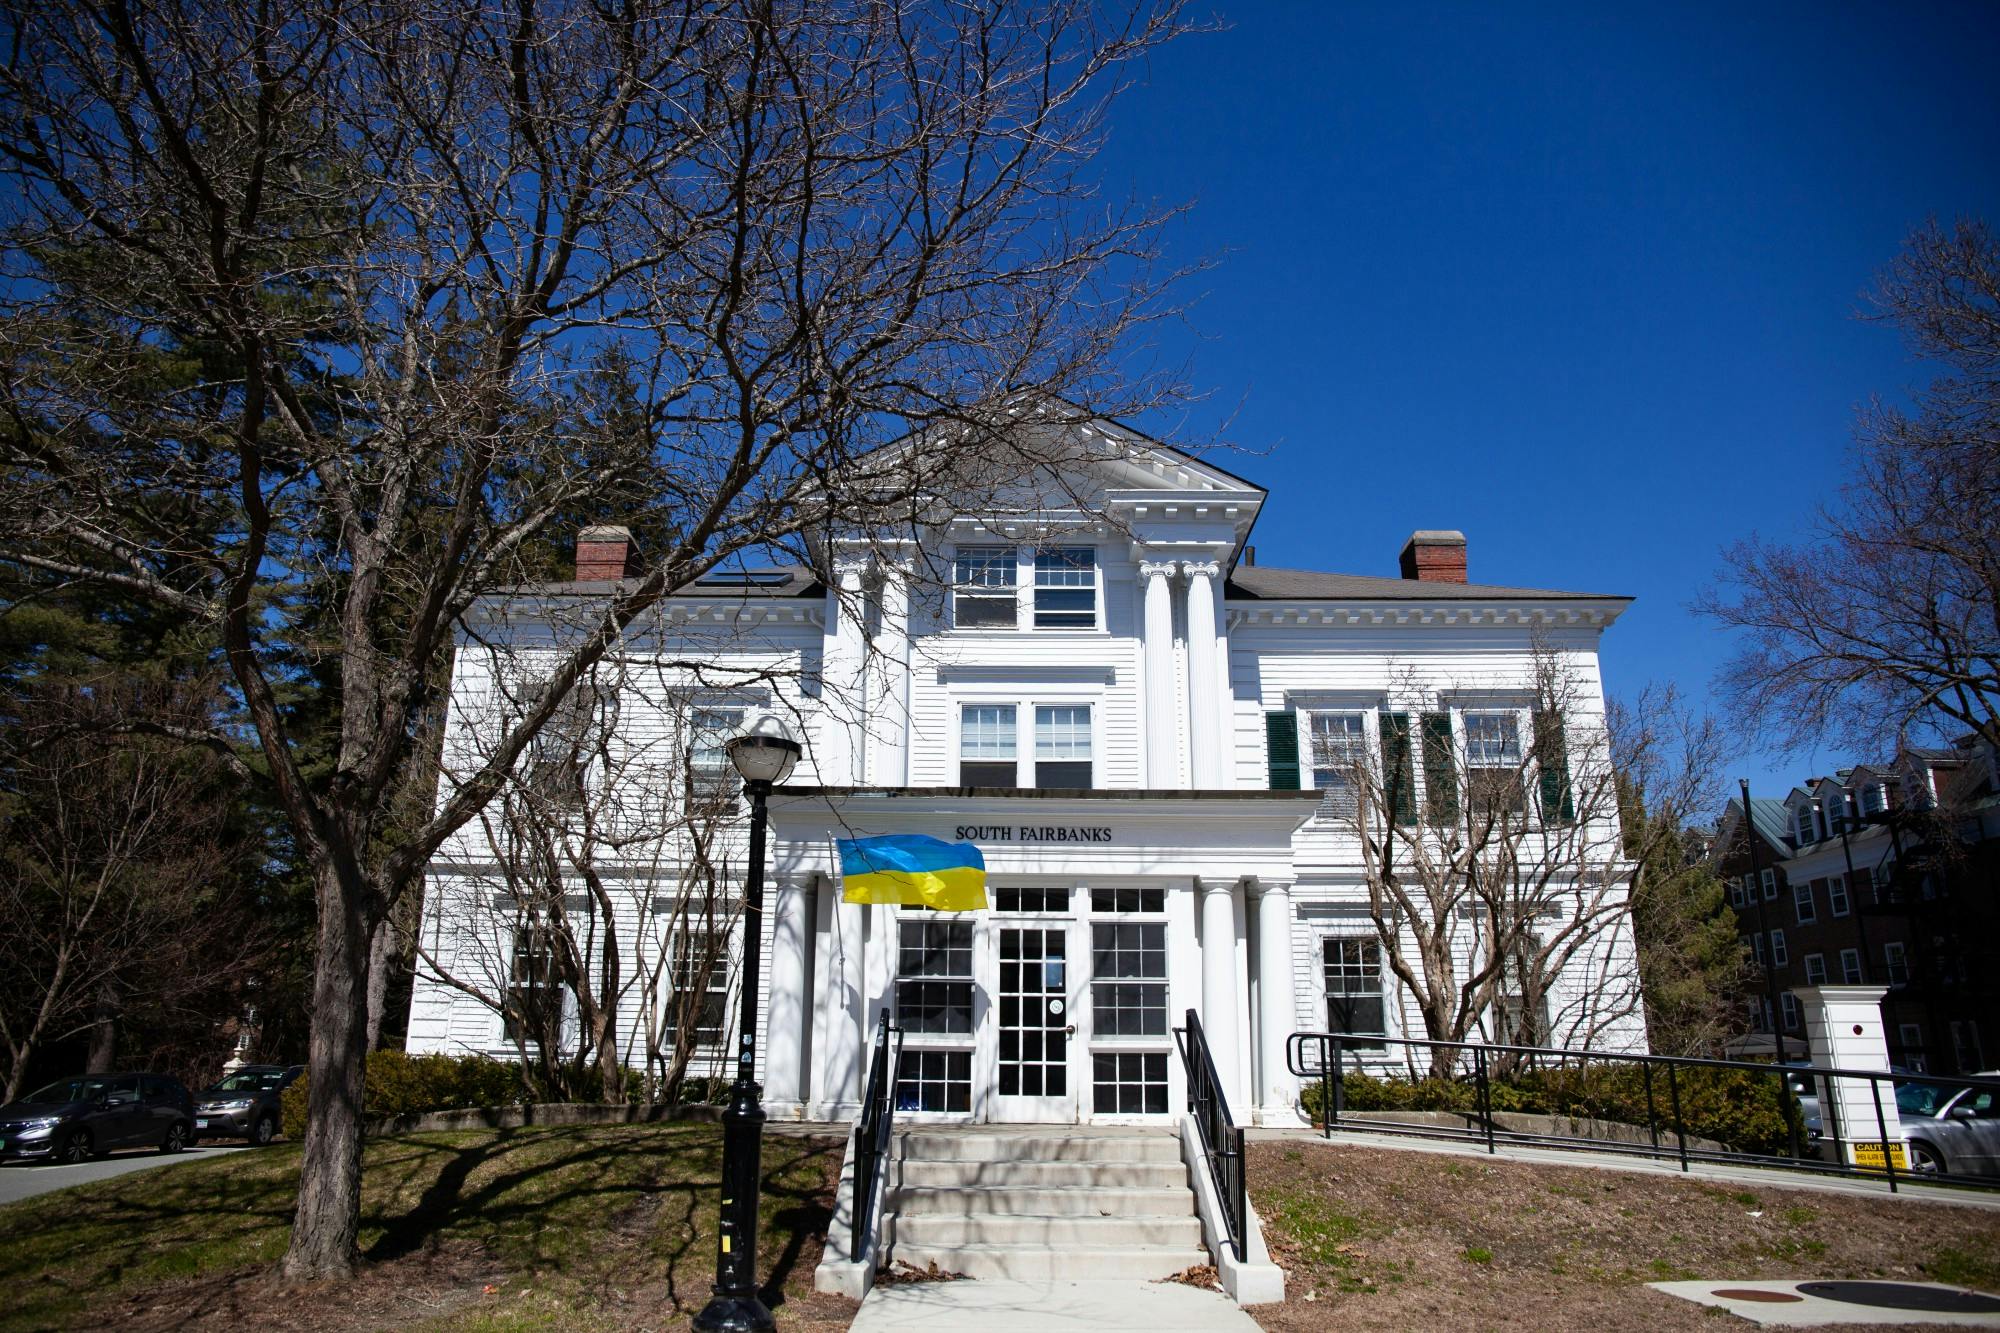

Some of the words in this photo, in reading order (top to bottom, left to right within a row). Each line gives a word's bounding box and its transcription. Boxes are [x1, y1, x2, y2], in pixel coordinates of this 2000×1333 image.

[955, 826, 1012, 841] SOUTH
[1019, 826, 1112, 842] FAIRBANKS
[1856, 1143, 1900, 1151] CAUTON
